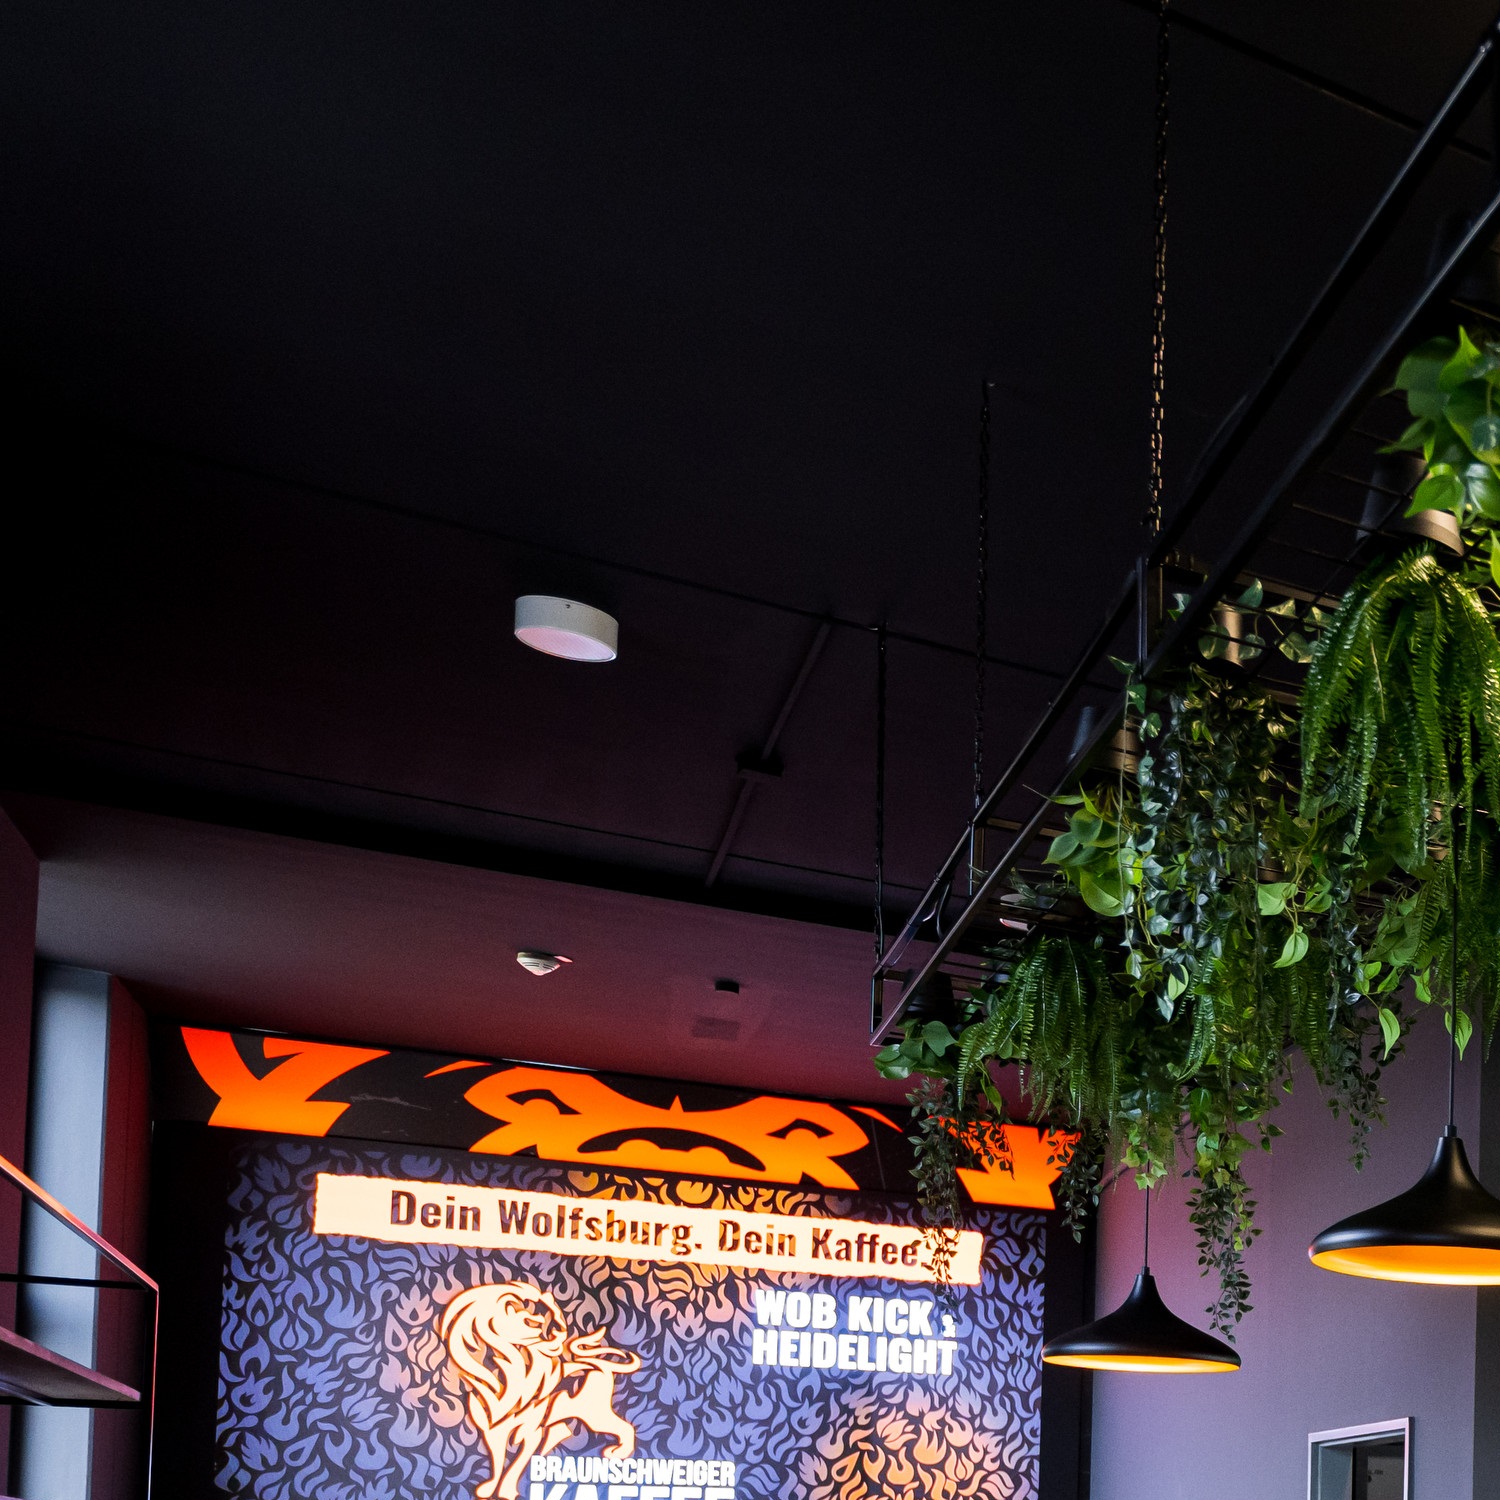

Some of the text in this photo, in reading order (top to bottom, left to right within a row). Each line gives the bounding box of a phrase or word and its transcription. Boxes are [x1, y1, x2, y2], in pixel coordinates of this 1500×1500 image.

[390, 1189, 481, 1232] Dein
[498, 1199, 702, 1257] Wolfsburg.
[718, 1218, 797, 1257] Dein
[755, 1289, 837, 1330] WOB
[850, 1295, 934, 1337] KICK
[752, 1328, 958, 1376] HEIDELIGHT
[530, 1455, 736, 1487] BRAUNSCHWEIGER
